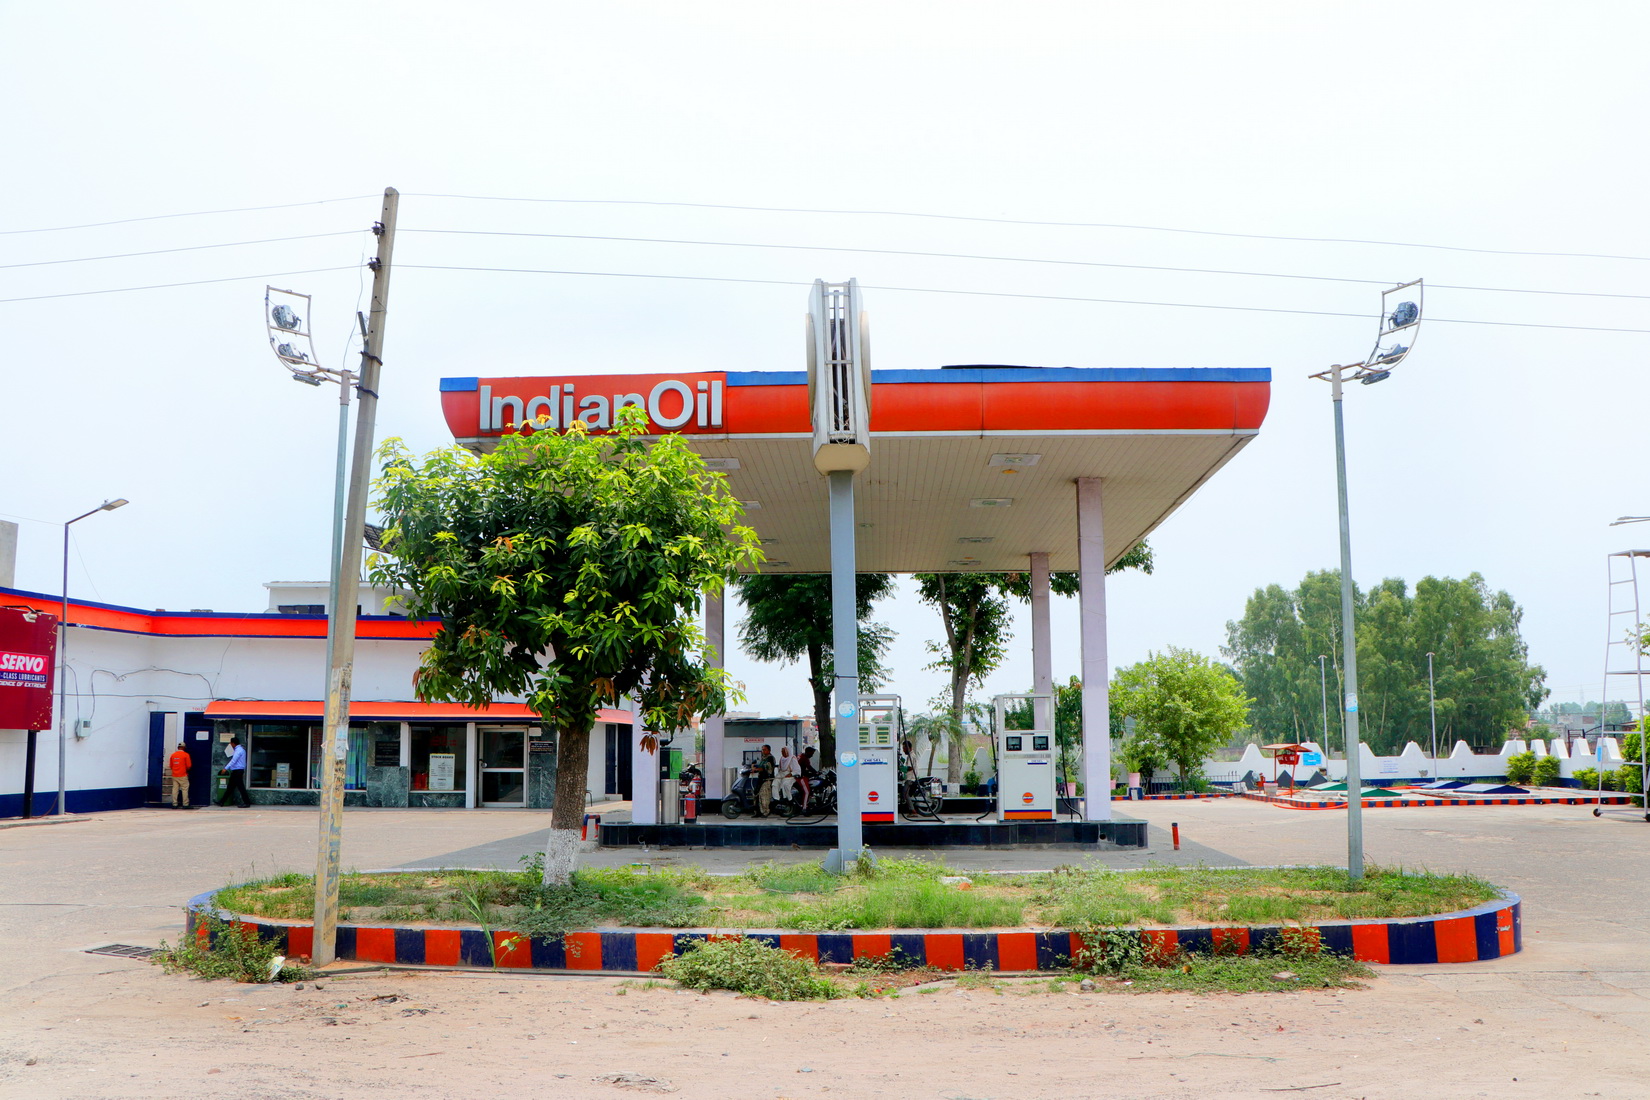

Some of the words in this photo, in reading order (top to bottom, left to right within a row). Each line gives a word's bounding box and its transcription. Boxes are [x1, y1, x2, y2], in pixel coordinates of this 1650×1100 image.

[480, 380, 723, 432] IndianOil
[0, 654, 44, 672] SERVO
[18, 673, 46, 682] LUBRICANTS
